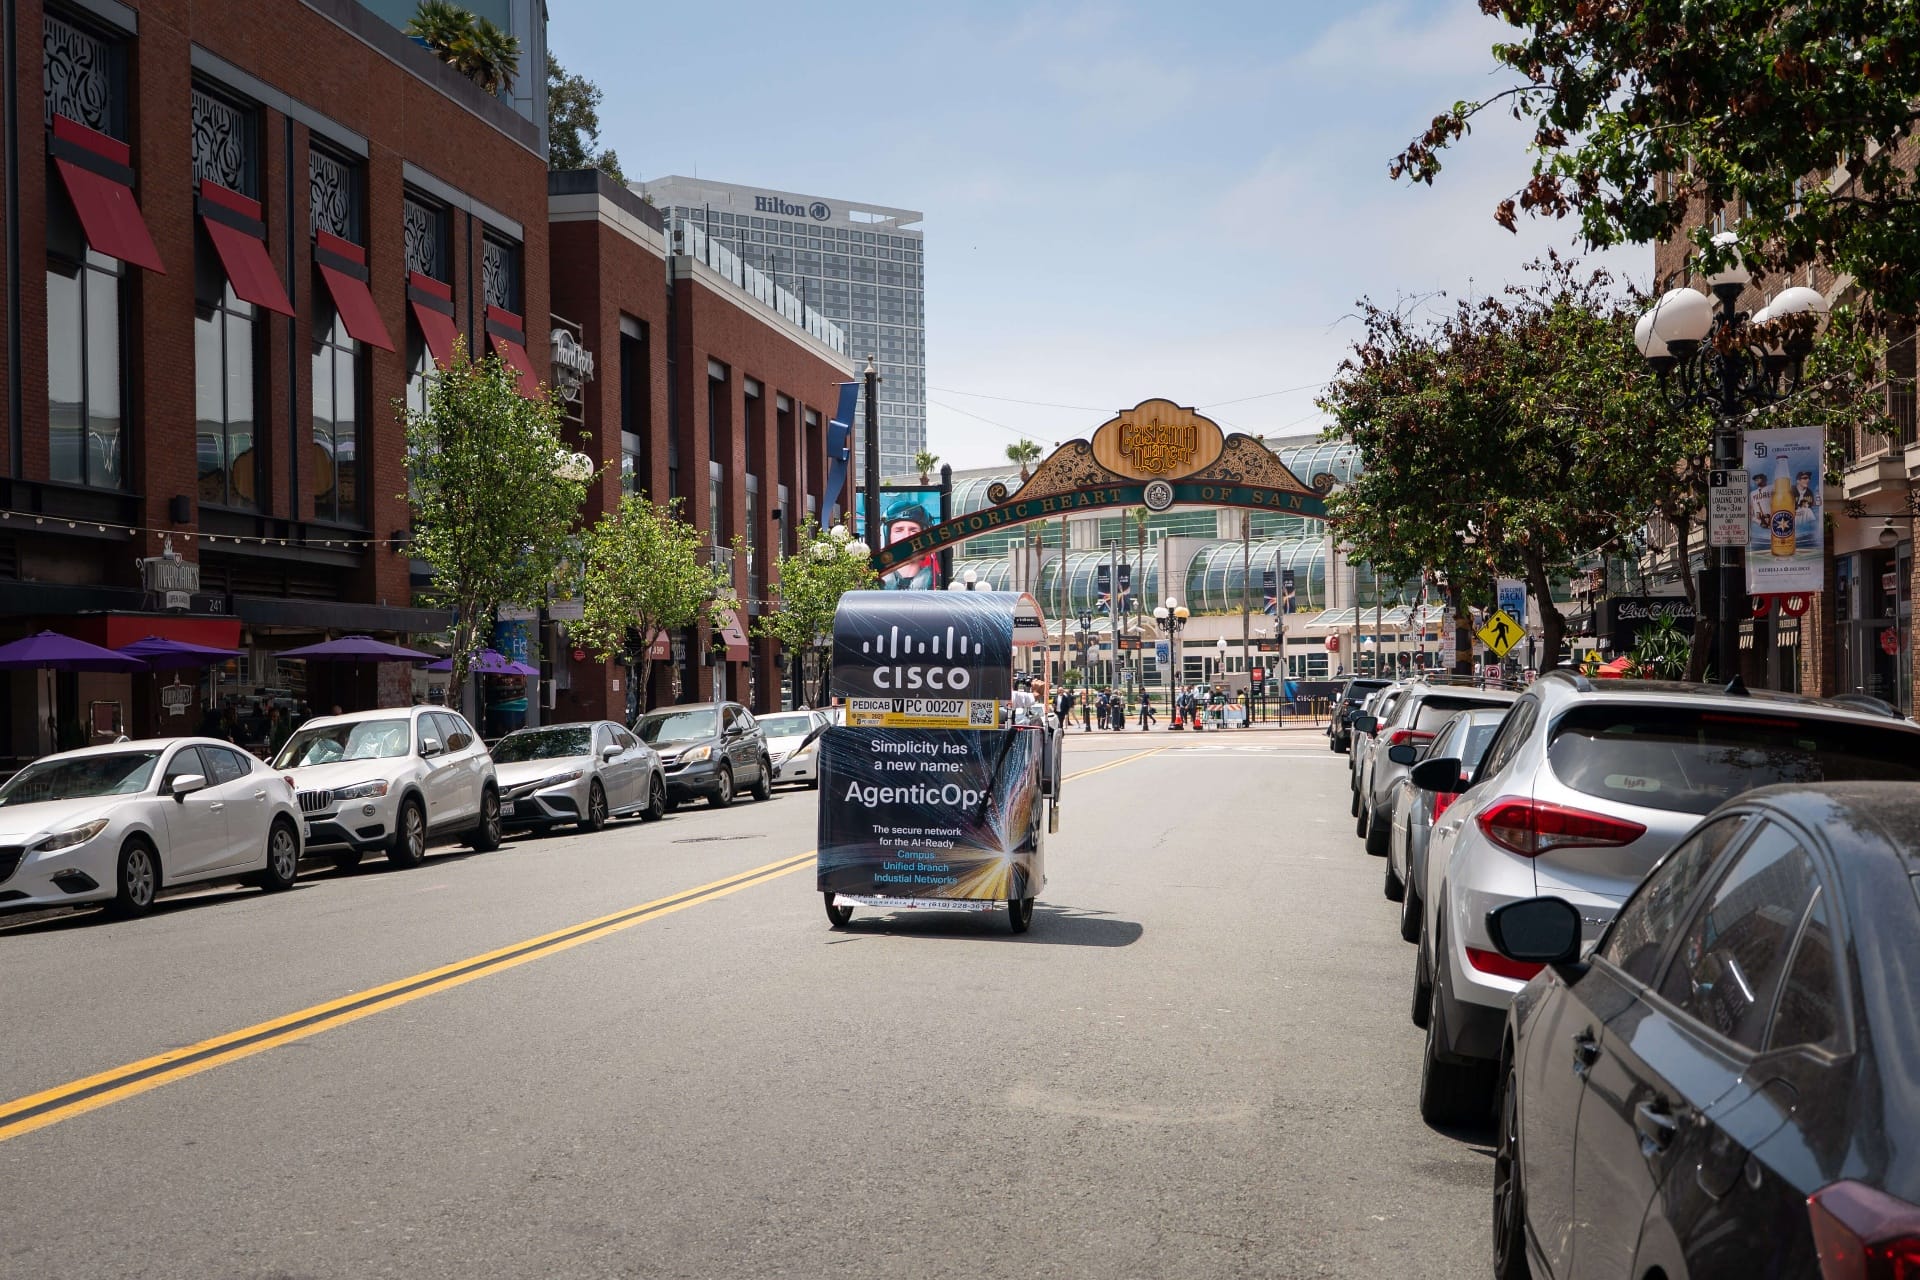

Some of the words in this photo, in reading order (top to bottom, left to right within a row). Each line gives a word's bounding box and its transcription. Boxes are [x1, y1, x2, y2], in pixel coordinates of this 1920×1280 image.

[755, 196, 806, 217] Hilton
[1716, 472, 1722, 485] 3
[1728, 475, 1747, 483] MINUTE
[1715, 488, 1743, 496] PASSENGER
[910, 503, 1028, 552] HISTORIC
[1042, 488, 1121, 512] HEART
[1201, 487, 1232, 500] OF
[1252, 490, 1304, 510] SAN
[209, 599, 222, 613] 241
[873, 666, 970, 690] CISCO
[852, 700, 890, 710] PEDICAB
[906, 700, 922, 713] PC
[926, 700, 964, 713] 00207
[871, 739, 939, 757] Simplicity
[943, 741, 968, 754] has
[874, 760, 882, 771] a
[886, 760, 916, 771] new
[920, 762, 963, 773] name:
[872, 825, 889, 834] The
[891, 826, 922, 835] secure
[925, 827, 962, 836] network
[879, 837, 893, 846] for
[894, 838, 909, 847] the
[911, 838, 954, 850] AI-Ready
[897, 850, 935, 861] Campus
[883, 861, 915, 871] Unified
[917, 862, 949, 872] Branch
[914, 874, 959, 885] Networks
